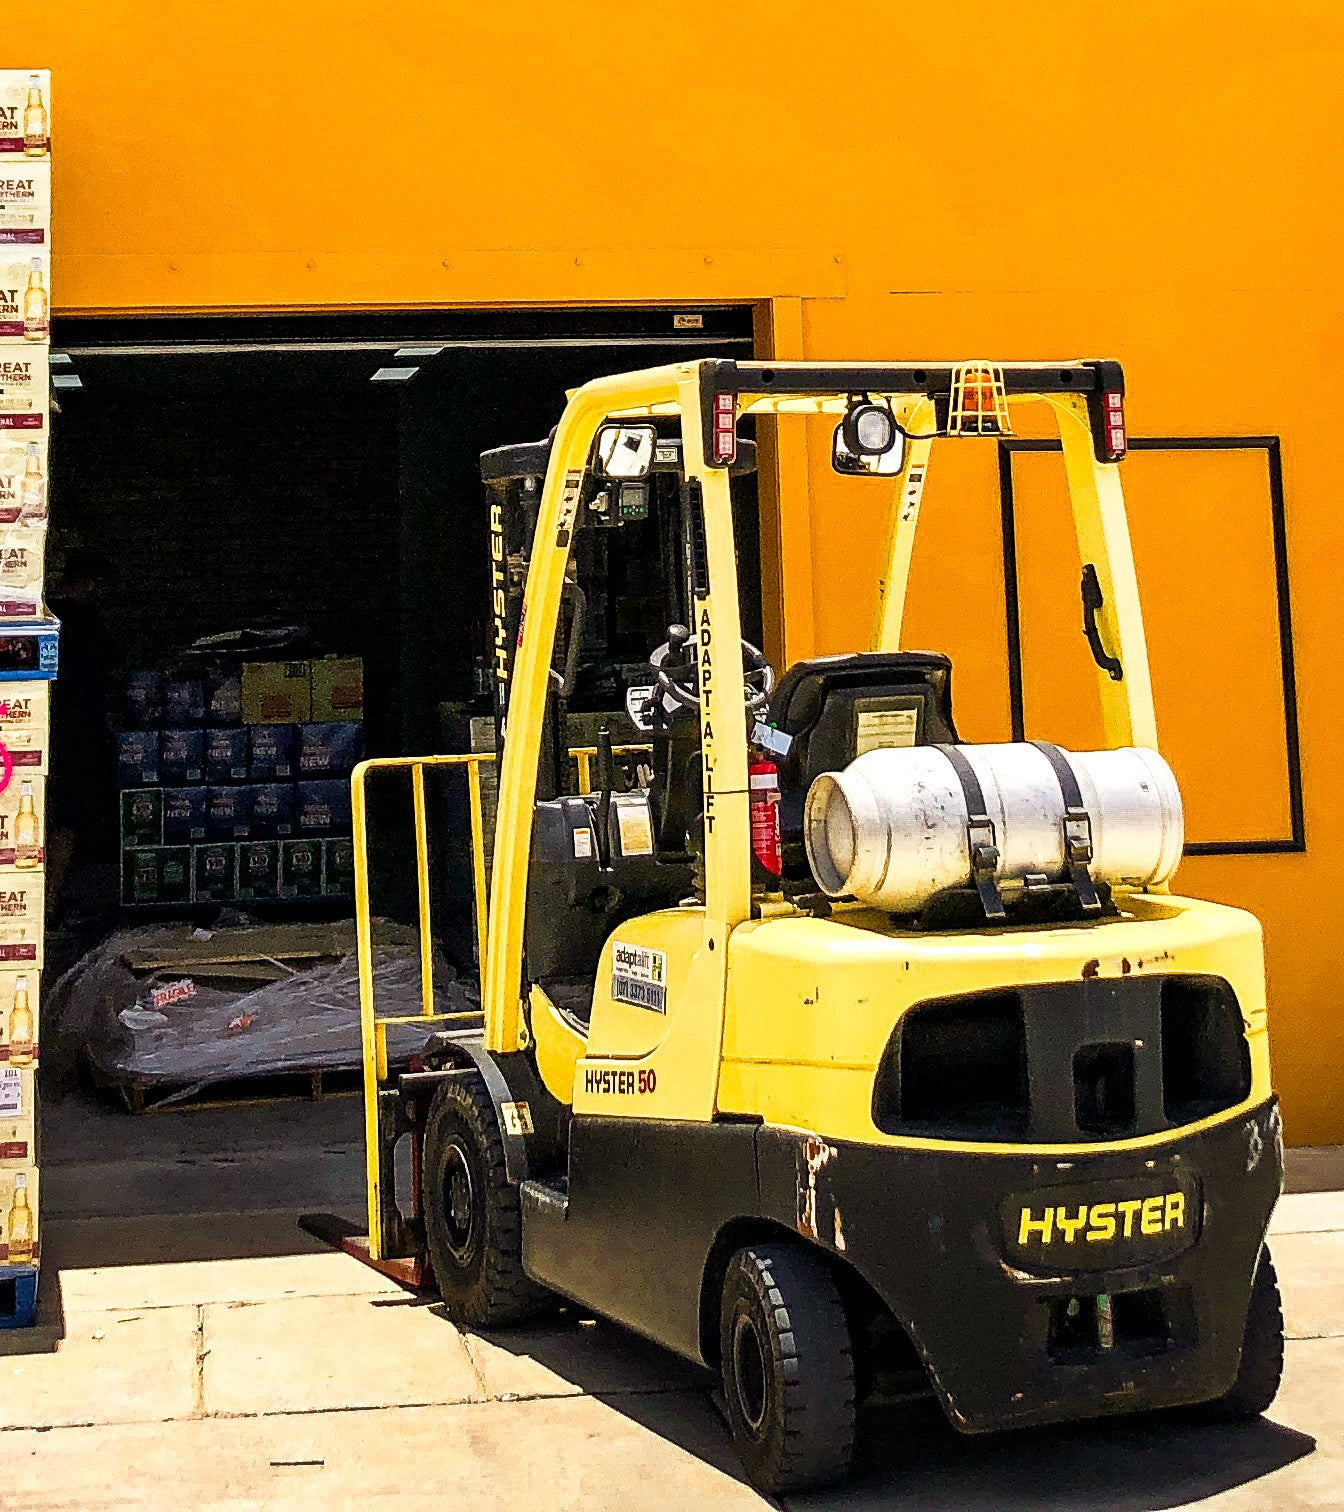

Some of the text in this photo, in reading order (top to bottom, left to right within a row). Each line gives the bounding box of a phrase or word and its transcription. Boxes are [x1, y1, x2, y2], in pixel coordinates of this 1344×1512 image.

[490, 504, 508, 680] HYSTER
[585, 1069, 656, 1094] HYSTER 50
[1018, 1191, 1185, 1245] HYSTER
